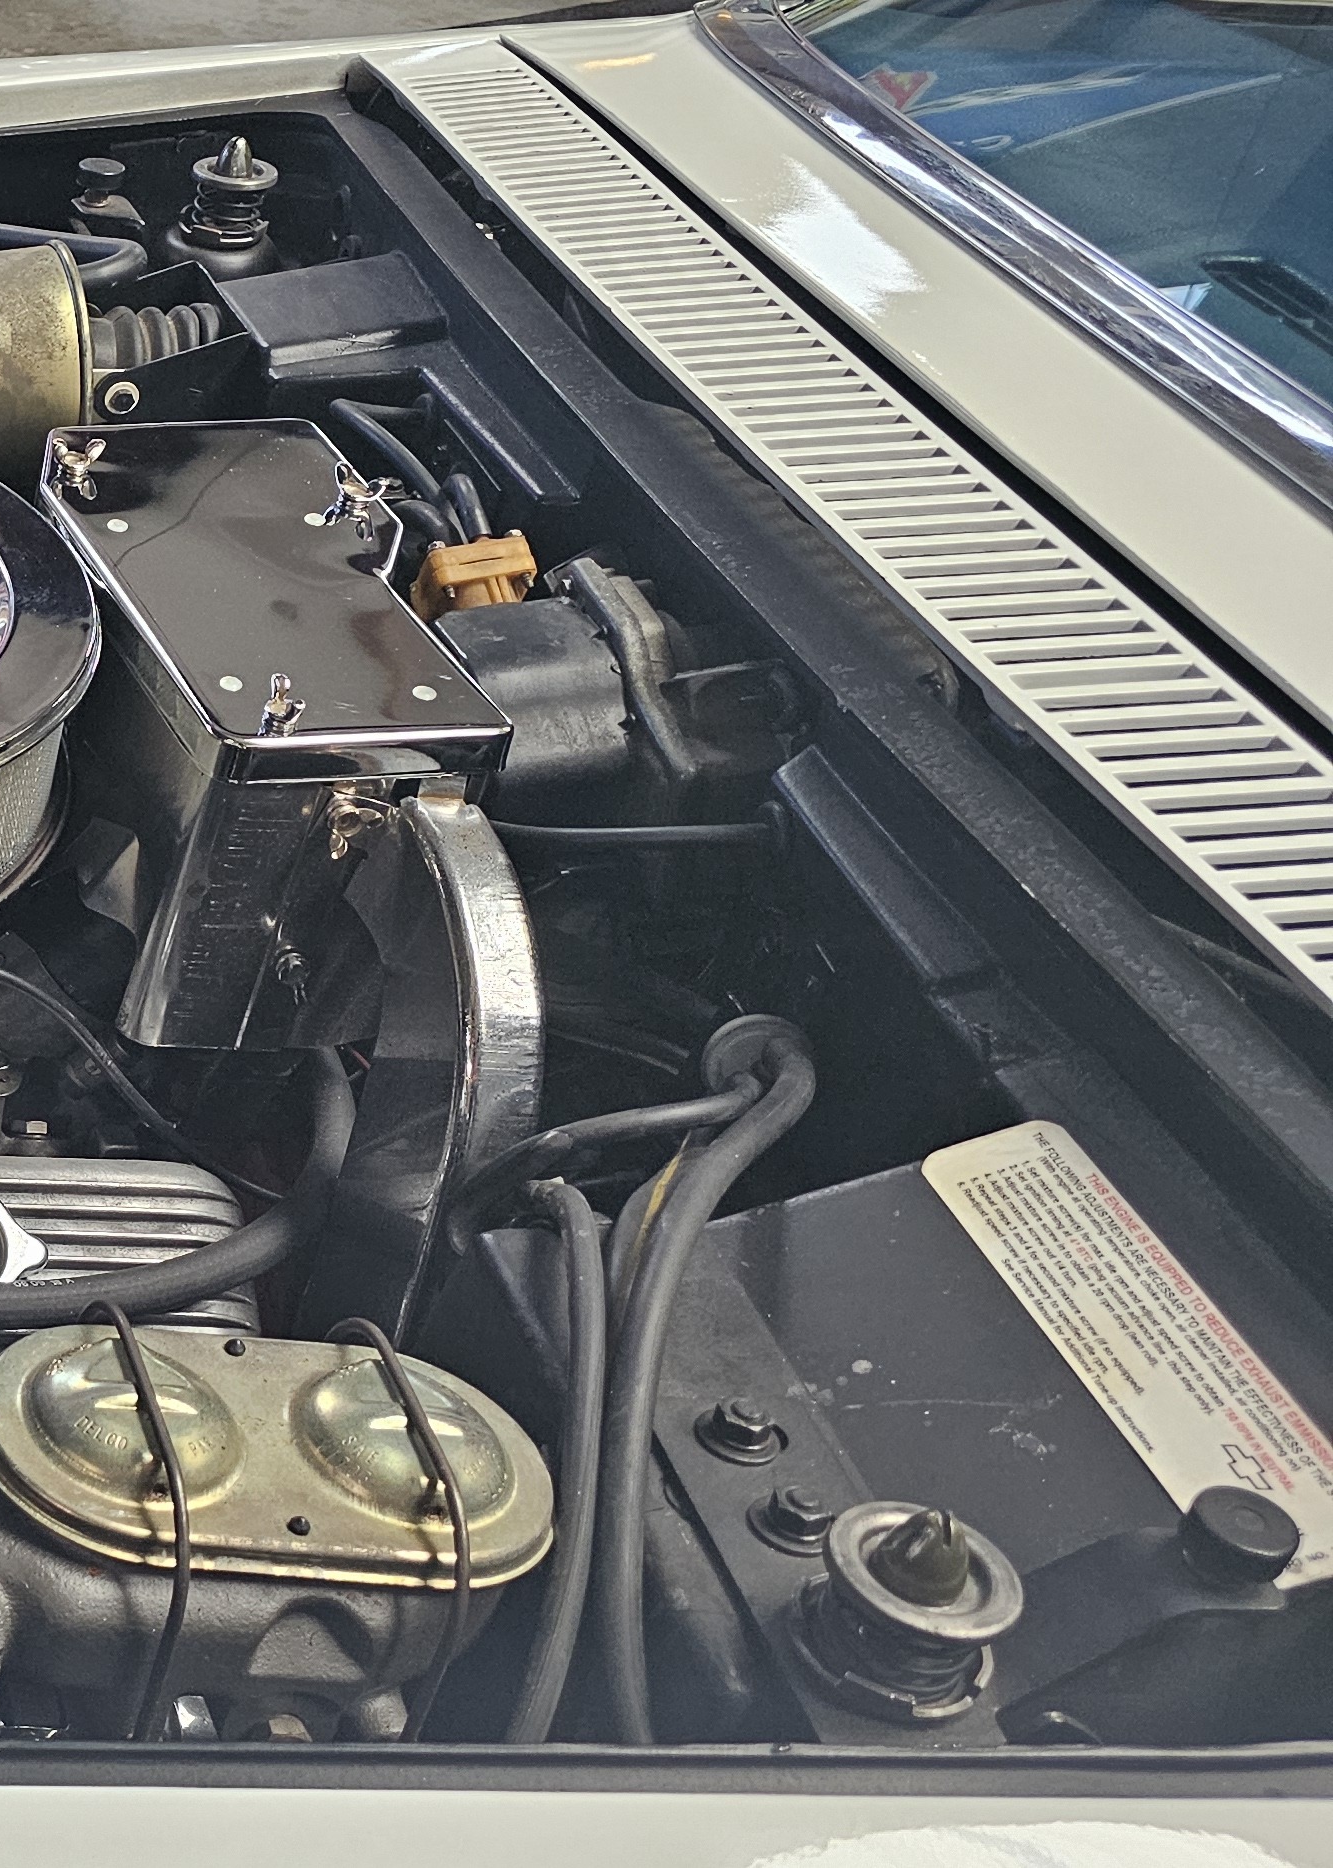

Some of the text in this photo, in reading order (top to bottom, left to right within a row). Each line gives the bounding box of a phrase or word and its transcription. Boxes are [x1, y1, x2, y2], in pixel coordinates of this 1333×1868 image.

[962, 1187, 988, 1217] Readjust
[985, 1217, 1004, 1238] speed
[1003, 1238, 1020, 1258] screw
[1021, 1264, 1052, 1300] necessary
[1056, 1309, 1085, 1341] specified
[975, 1183, 997, 1207] Repeat
[994, 1207, 1012, 1226] steps
[1038, 1262, 1060, 1287] second
[1058, 1287, 1081, 1314] mixture
[1080, 1315, 1098, 1336] screw
[989, 1179, 1009, 1201] Adjust
[1008, 1200, 1029, 1226] mixture
[1028, 1227, 1046, 1247] screw
[1002, 1174, 1023, 1197] Adjust
[1021, 1196, 1043, 1222] mixture
[1042, 1222, 1059, 1242] screw
[1071, 1259, 1090, 1281] obtain
[1099, 1297, 1115, 1313] rpm
[1112, 1312, 1130, 1331] drop
[1024, 1182, 1047, 1208] ignition
[1044, 1207, 1065, 1230] timing
[1106, 1282, 1130, 1310] vacuum
[1128, 1310, 1155, 1340] advance
[1180, 1376, 1198, 1392] step
[1038, 1178, 1060, 1203] mixture
[1139, 1304, 1161, 1327] adjust
[1158, 1327, 1179, 1350] speed
[1177, 1350, 1197, 1372] screw
[1203, 1382, 1226, 1406] obtain
[1014, 1272, 1036, 1298] Service
[1034, 1298, 1056, 1324] Manual
[1063, 1336, 1094, 1373] Additional
[1046, 1147, 1086, 1191] FOLLOWING
[1082, 1191, 1134, 1247] ADJUSTMENTS
[1129, 1247, 1147, 1265] ARE
[1143, 1266, 1189, 1315] NECESSARY
[1195, 1328, 1234, 1369] MAINTAIN
[1229, 1369, 1248, 1387] THE
[1311, 1468, 1332, 1489] THE
[1053, 1173, 1074, 1196] engine
[1077, 1203, 1108, 1235] operating
[1141, 1279, 1161, 1301] choke
[1185, 1333, 1210, 1361] cleaner
[1243, 1407, 1289, 1457] conditioning
[1086, 1173, 1109, 1196] THIS
[1105, 1195, 1141, 1233] ENGINE
[1145, 1244, 1194, 1296] EQUIPPED
[1189, 1296, 1208, 1312] TO
[1203, 1313, 1246, 1357] REDUCE
[1240, 1358, 1290, 1409] EXHAUST
[1283, 1411, 1333, 1472] EMMISSIO
